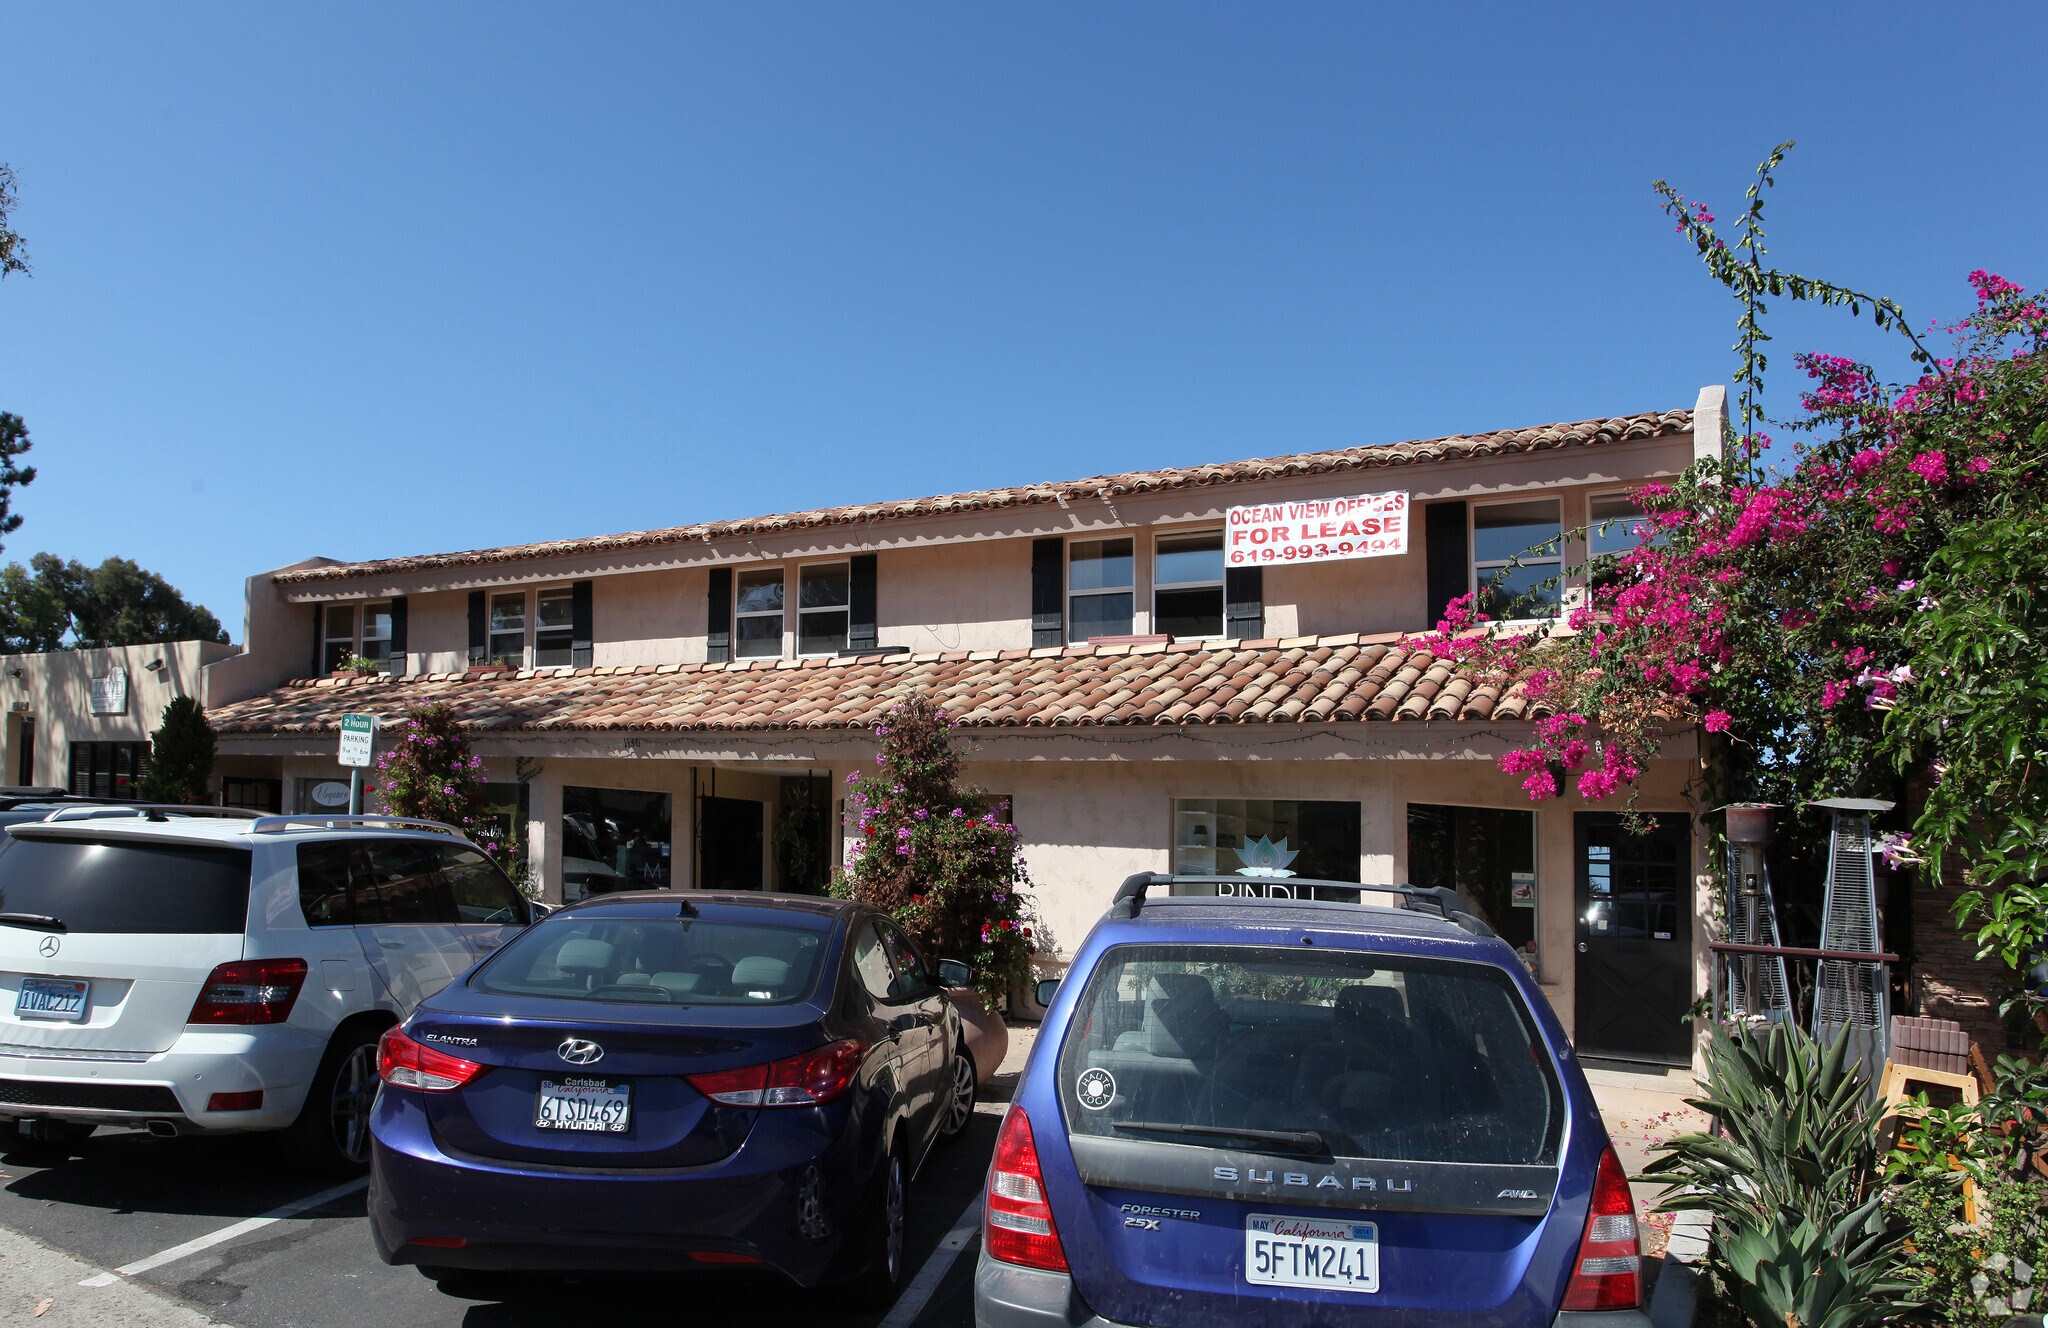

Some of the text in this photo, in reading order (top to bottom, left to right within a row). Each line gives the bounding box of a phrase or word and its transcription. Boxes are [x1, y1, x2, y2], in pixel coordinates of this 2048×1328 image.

[1230, 506, 1283, 525] OCEAN
[1289, 502, 1330, 520] VIEW
[1233, 516, 1401, 545] FOR LEASE
[1231, 537, 1401, 563] 619-993-9494
[343, 735, 369, 744] PARKING
[317, 785, 349, 804] Elegance
[20, 991, 80, 1012] 1VAC212
[426, 1034, 478, 1046] ELANTRA
[565, 1077, 606, 1087] Carlsbad
[1081, 1072, 1111, 1090] HAUTE
[558, 1085, 613, 1097] California
[1081, 1090, 1111, 1105] YOGA
[541, 1096, 624, 1123] 6TSD469
[555, 1120, 606, 1131] HYUNDAI
[1213, 1166, 1412, 1193] SUBARU
[1497, 1189, 1538, 1199] AWD
[1120, 1203, 1201, 1220] FORESTER
[1252, 1220, 1270, 1230] MAY
[1273, 1220, 1354, 1242] California
[1254, 1239, 1370, 1281] 5FTM241
